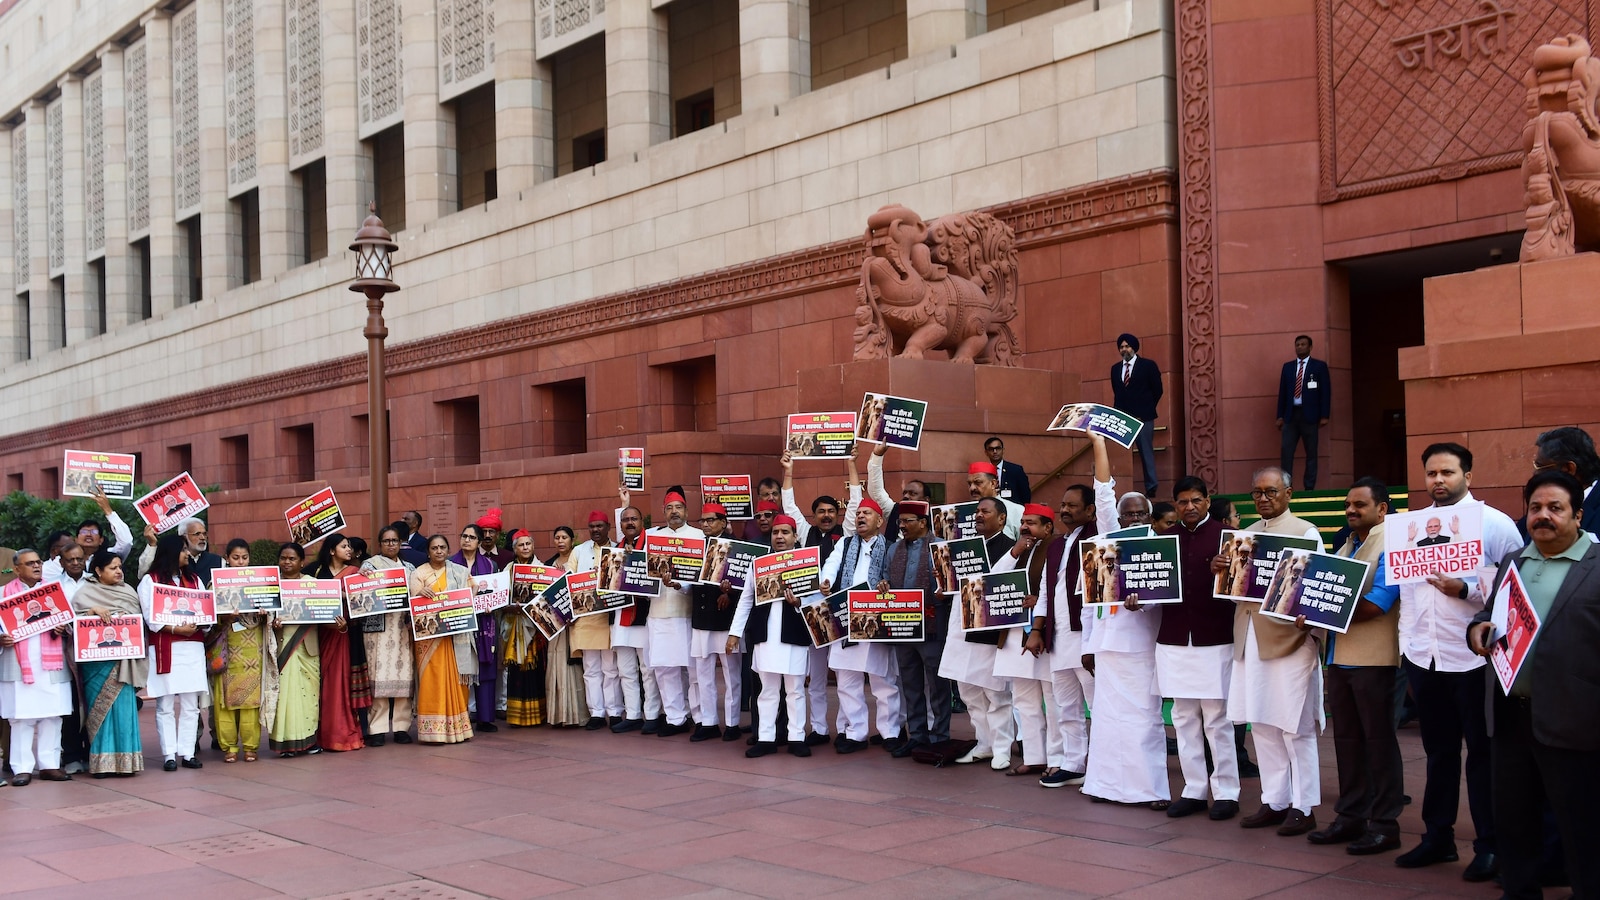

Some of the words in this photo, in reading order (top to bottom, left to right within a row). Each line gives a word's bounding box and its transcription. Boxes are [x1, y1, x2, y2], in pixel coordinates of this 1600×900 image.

[1392, 1, 1517, 70] जयते
[141, 478, 188, 509] NARENDER
[157, 499, 204, 532] SURRENDER
[1155, 552, 1161, 560] से
[1392, 542, 1479, 566] NARENDER
[1126, 570, 1148, 579] किसान
[1393, 557, 1479, 580] SURRENDER
[1139, 579, 1145, 588] से
[1315, 571, 1325, 579] US
[1337, 573, 1346, 583] से
[0, 585, 59, 611] NARENDER
[156, 588, 211, 599] NARENDER
[474, 590, 507, 604] RENDER
[1303, 586, 1326, 599] किसान
[1324, 593, 1334, 601] का
[474, 598, 507, 611] RENDER
[1311, 598, 1319, 608] से
[79, 618, 138, 628] NARENDER
[156, 613, 212, 624] SURRENDER
[12, 611, 72, 640] SURRENDER
[81, 646, 141, 658] SURRENDER
[1493, 644, 1513, 685] ENDER
